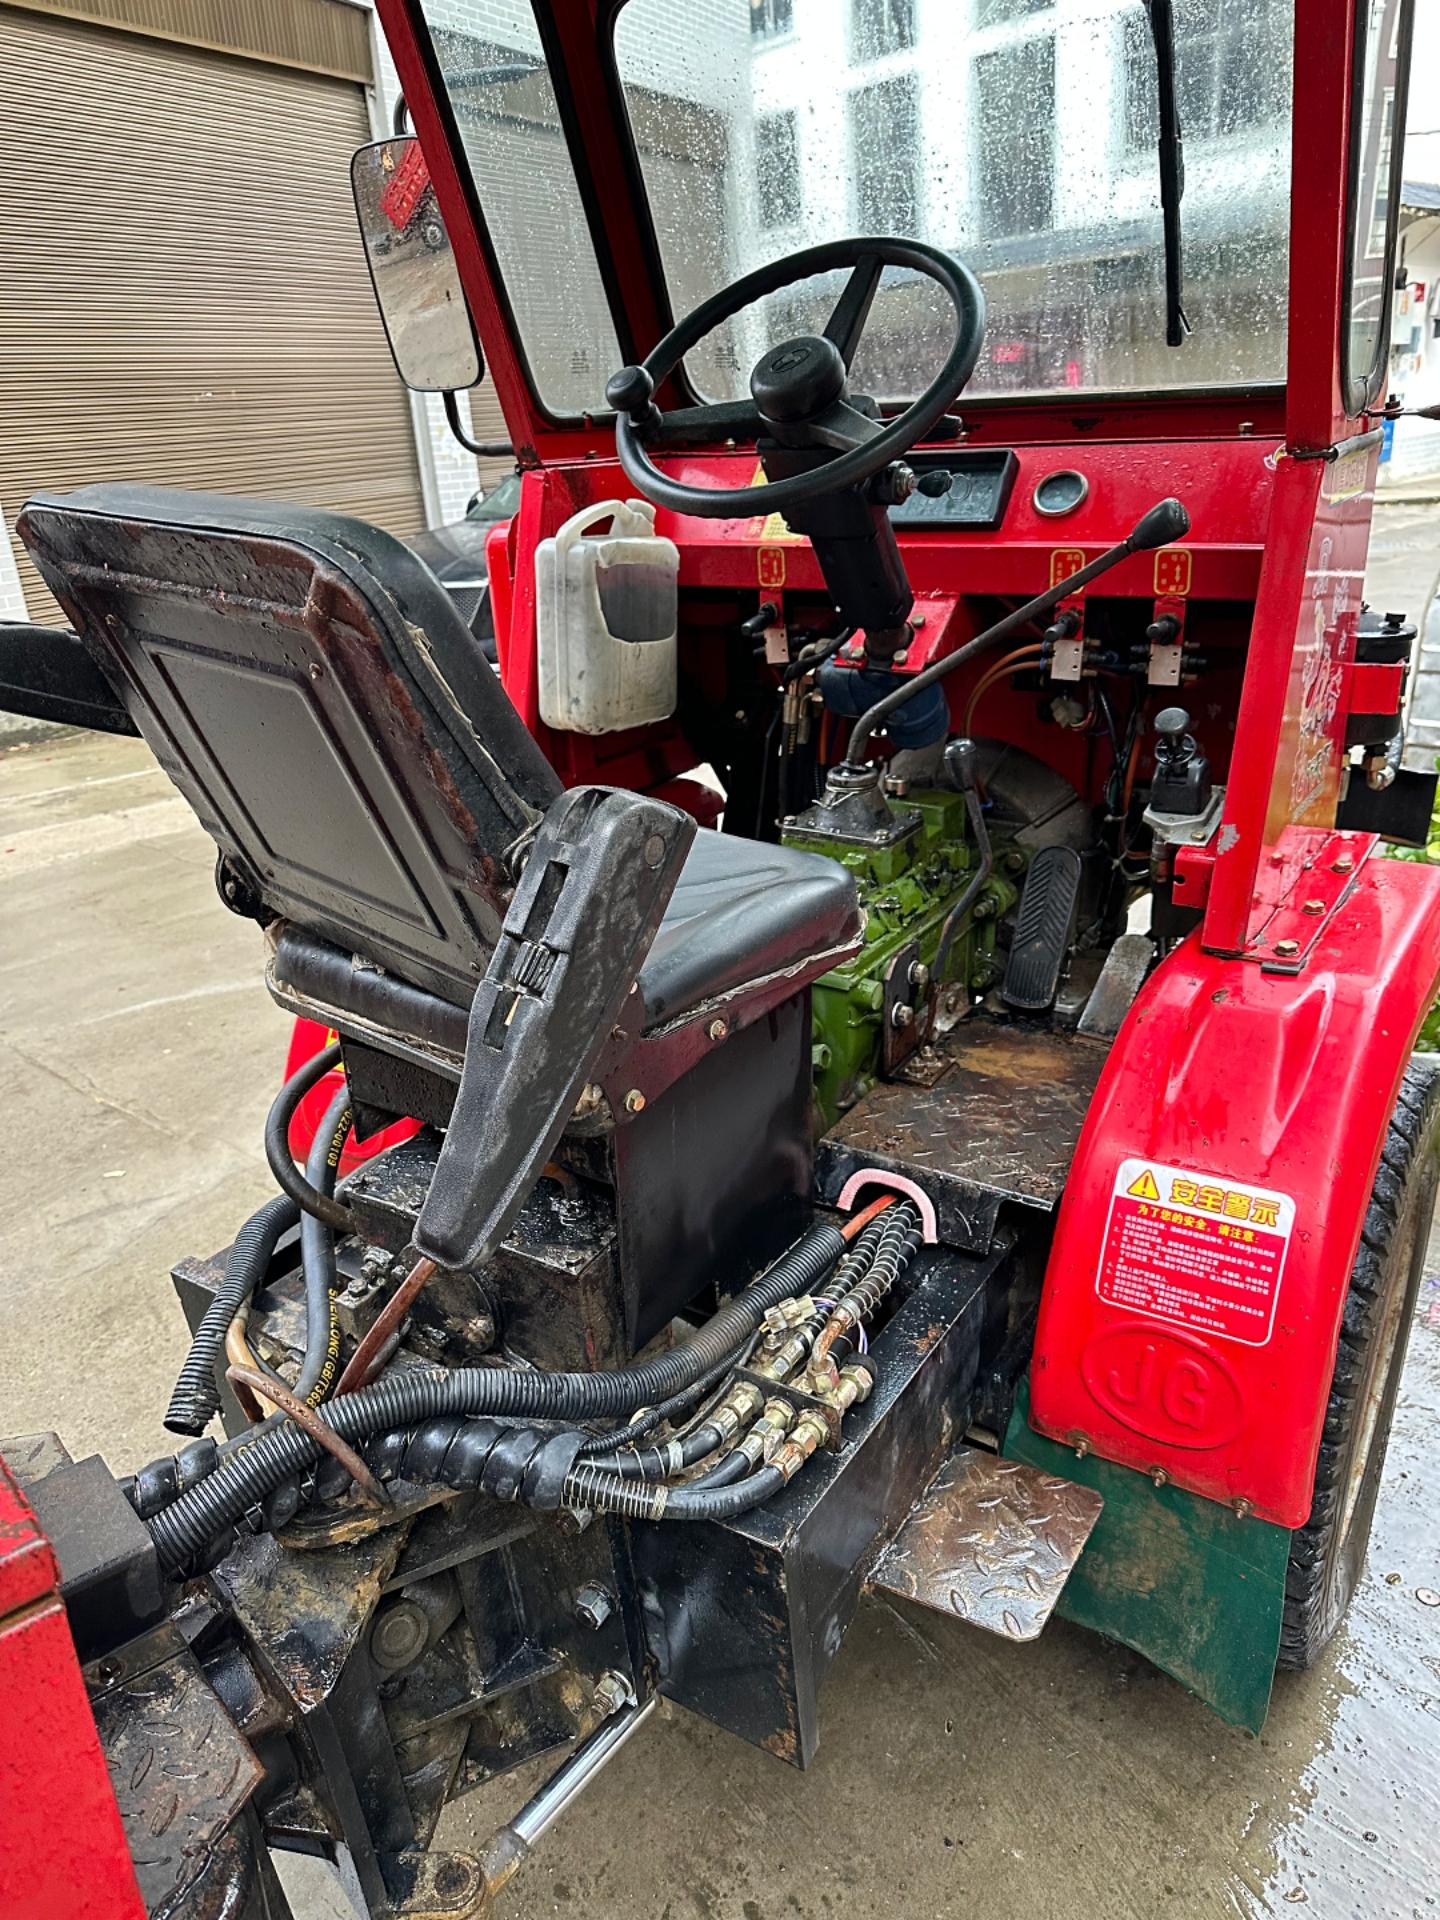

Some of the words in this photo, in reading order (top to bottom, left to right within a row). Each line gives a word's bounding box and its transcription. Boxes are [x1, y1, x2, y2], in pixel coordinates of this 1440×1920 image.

[328, 1107, 352, 1167] 022-00109
[1170, 1178, 1281, 1227] 安全警示
[305, 1288, 341, 1409] SHENLONG/GB/T368
[1108, 1344, 1210, 1431] JG
